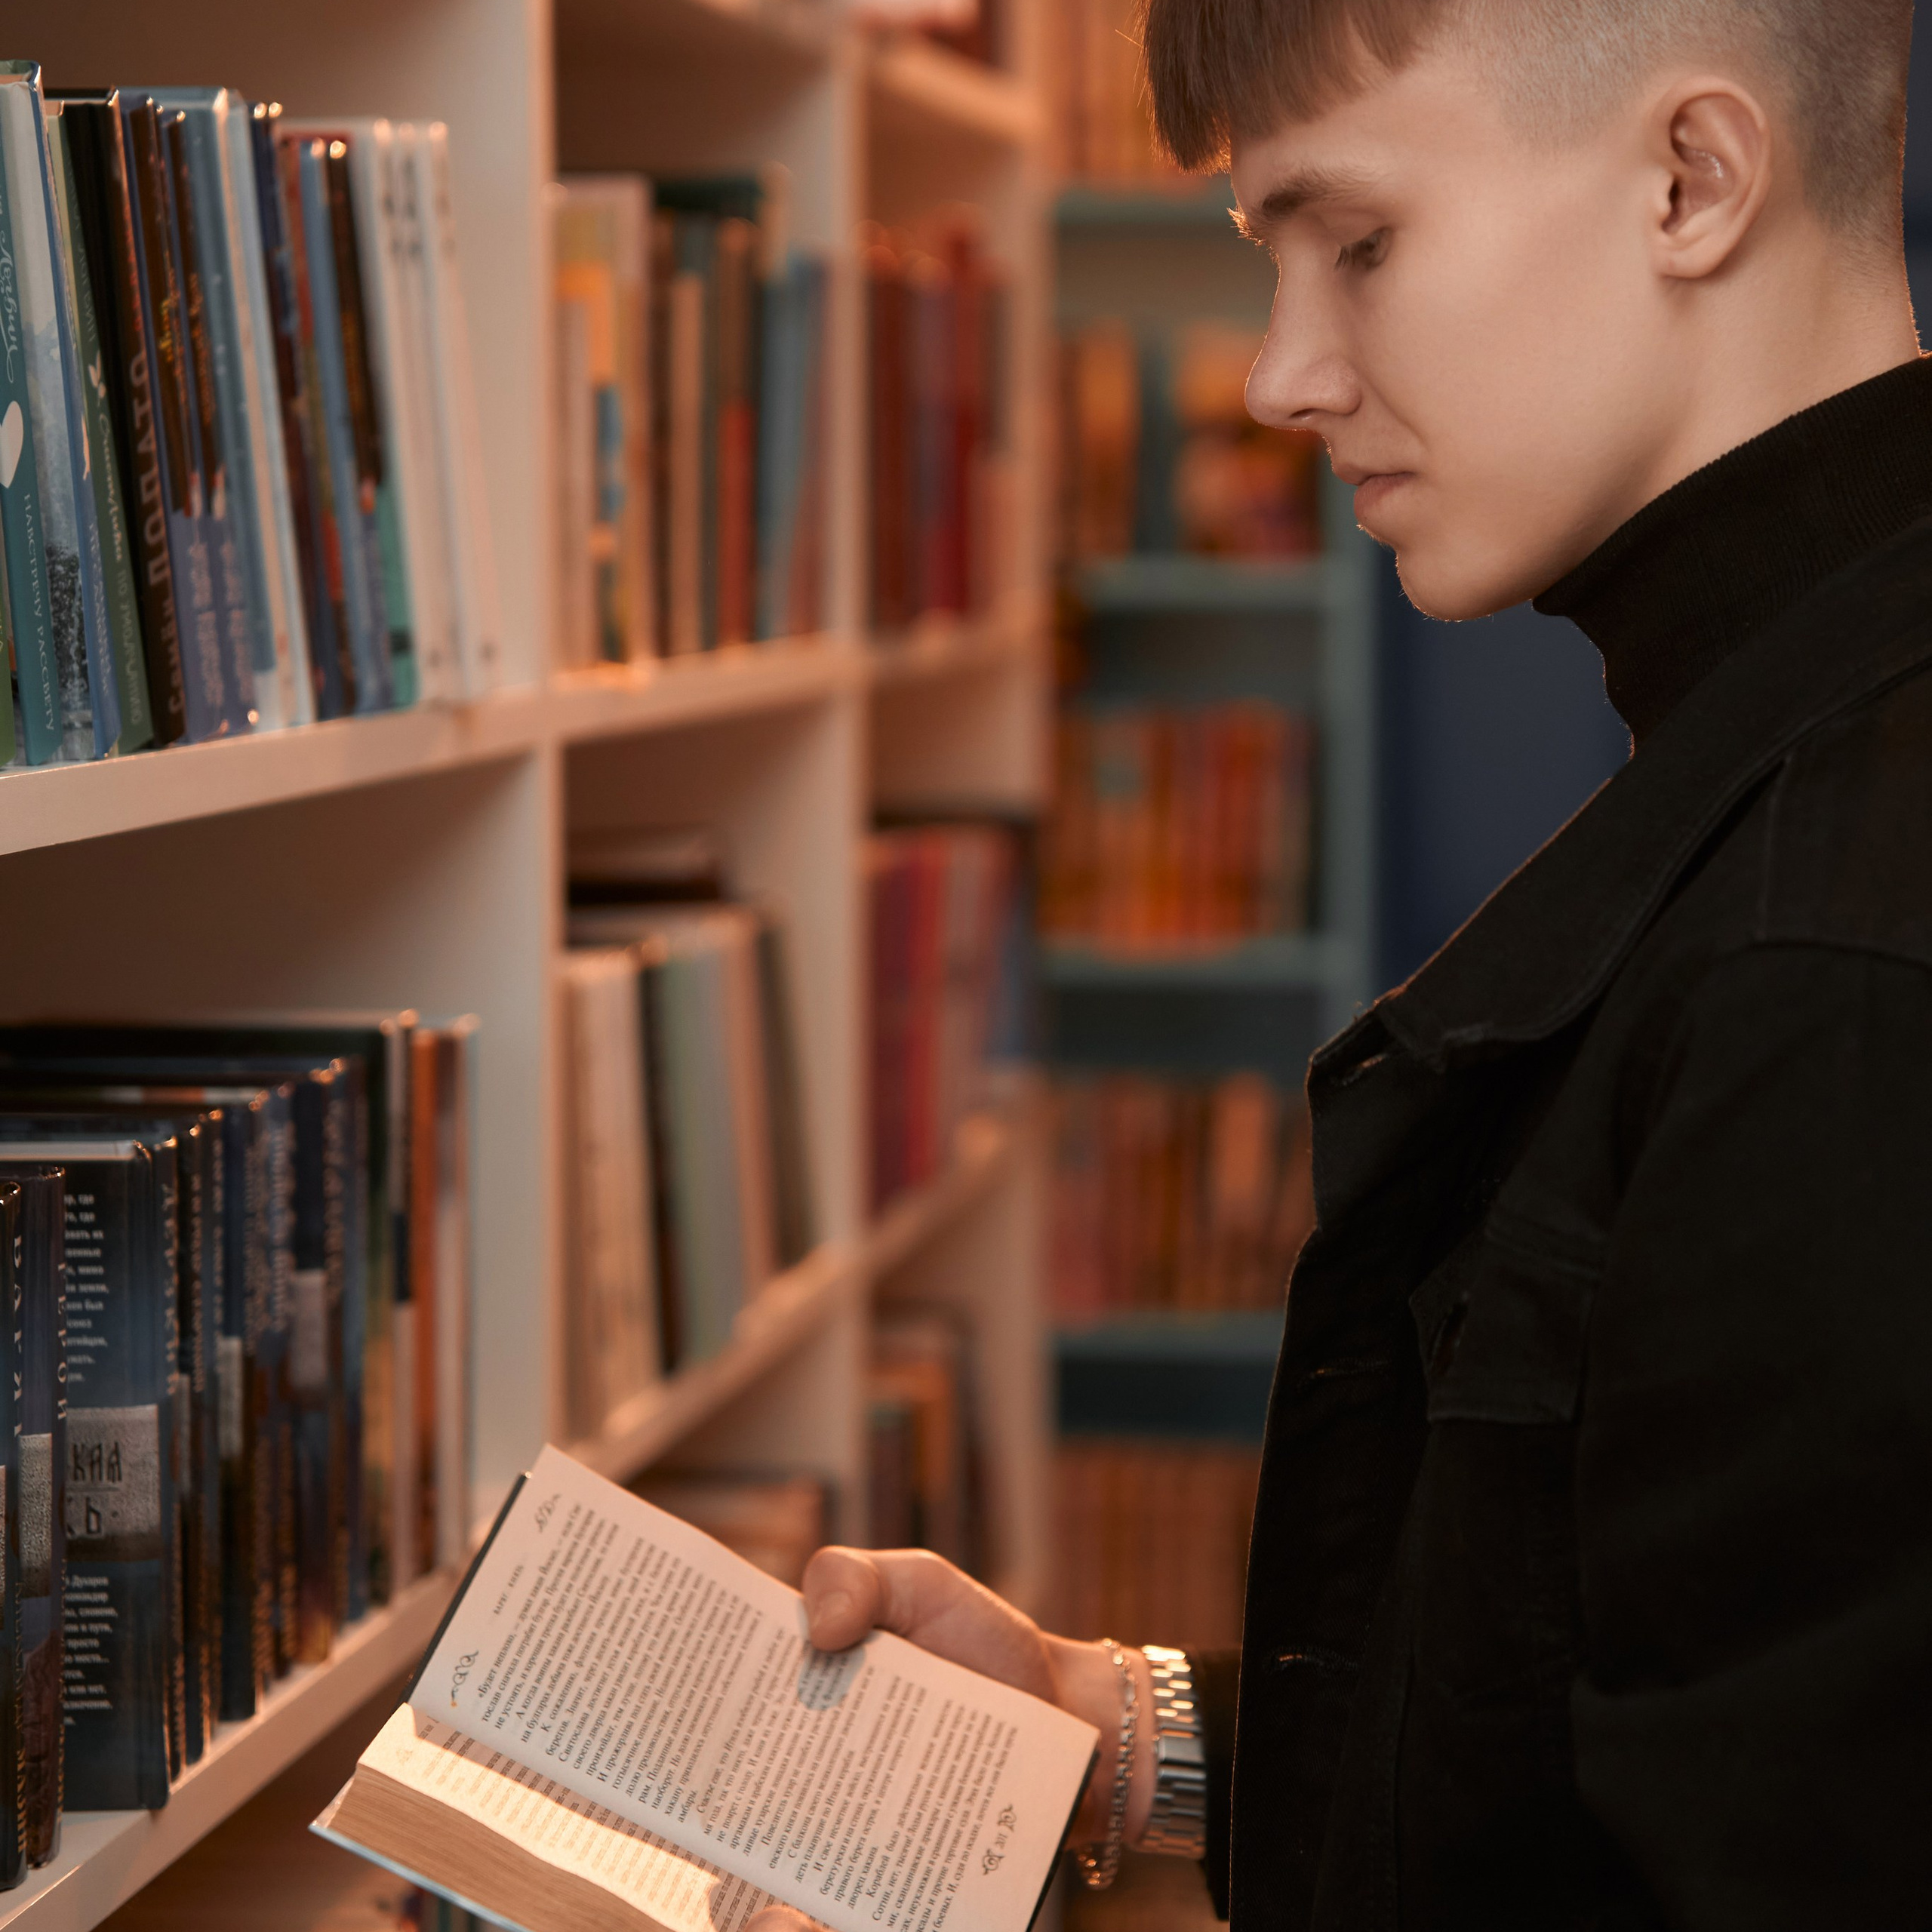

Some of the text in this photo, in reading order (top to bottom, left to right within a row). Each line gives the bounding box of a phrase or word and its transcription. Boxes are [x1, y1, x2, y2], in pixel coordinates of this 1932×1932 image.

[23, 493, 54, 731] НАВСТРЕЧУ РАССВЕТУ
[477, 1668, 497, 1699] «Будет
[521, 1684, 539, 1710] когда
[481, 1691, 502, 1723] тослав
[494, 1716, 506, 1730] не
[500, 1680, 525, 1718] устоять,
[525, 1691, 552, 1730] булгарах
[520, 1730, 532, 1743] на
[545, 1718, 569, 1757] берегов.
[558, 1712, 590, 1764] Святослава
[585, 1723, 618, 1777] произойдет,
[573, 1739, 592, 1770] своего
[611, 1739, 641, 1790] готысячное
[625, 1771, 641, 1798] долю
[638, 1783, 652, 1804] рам.
[651, 1767, 675, 1810] наоборот.
[663, 1786, 685, 1817] хакану
[696, 1783, 715, 1814] Счастье
[677, 1789, 697, 1823] амбары.
[703, 1823, 713, 1836] мя
[709, 1803, 724, 1823] года,
[718, 1789, 730, 1802] так
[715, 1830, 727, 1843] не
[721, 1801, 740, 1829] помрет
[729, 1805, 753, 1850] аргамакам
[743, 1827, 760, 1857] ливые
[768, 1834, 788, 1869] евского
[820, 1841, 833, 1861] свое
[795, 1861, 809, 1884] деть
[819, 1865, 838, 1896] берегу
[833, 1844, 848, 1867] реки
[834, 1865, 854, 1903] правого
[848, 1875, 867, 1910] дворец
[871, 1888, 894, 1921] Сотни,
[886, 1911, 900, 1928] ми,
